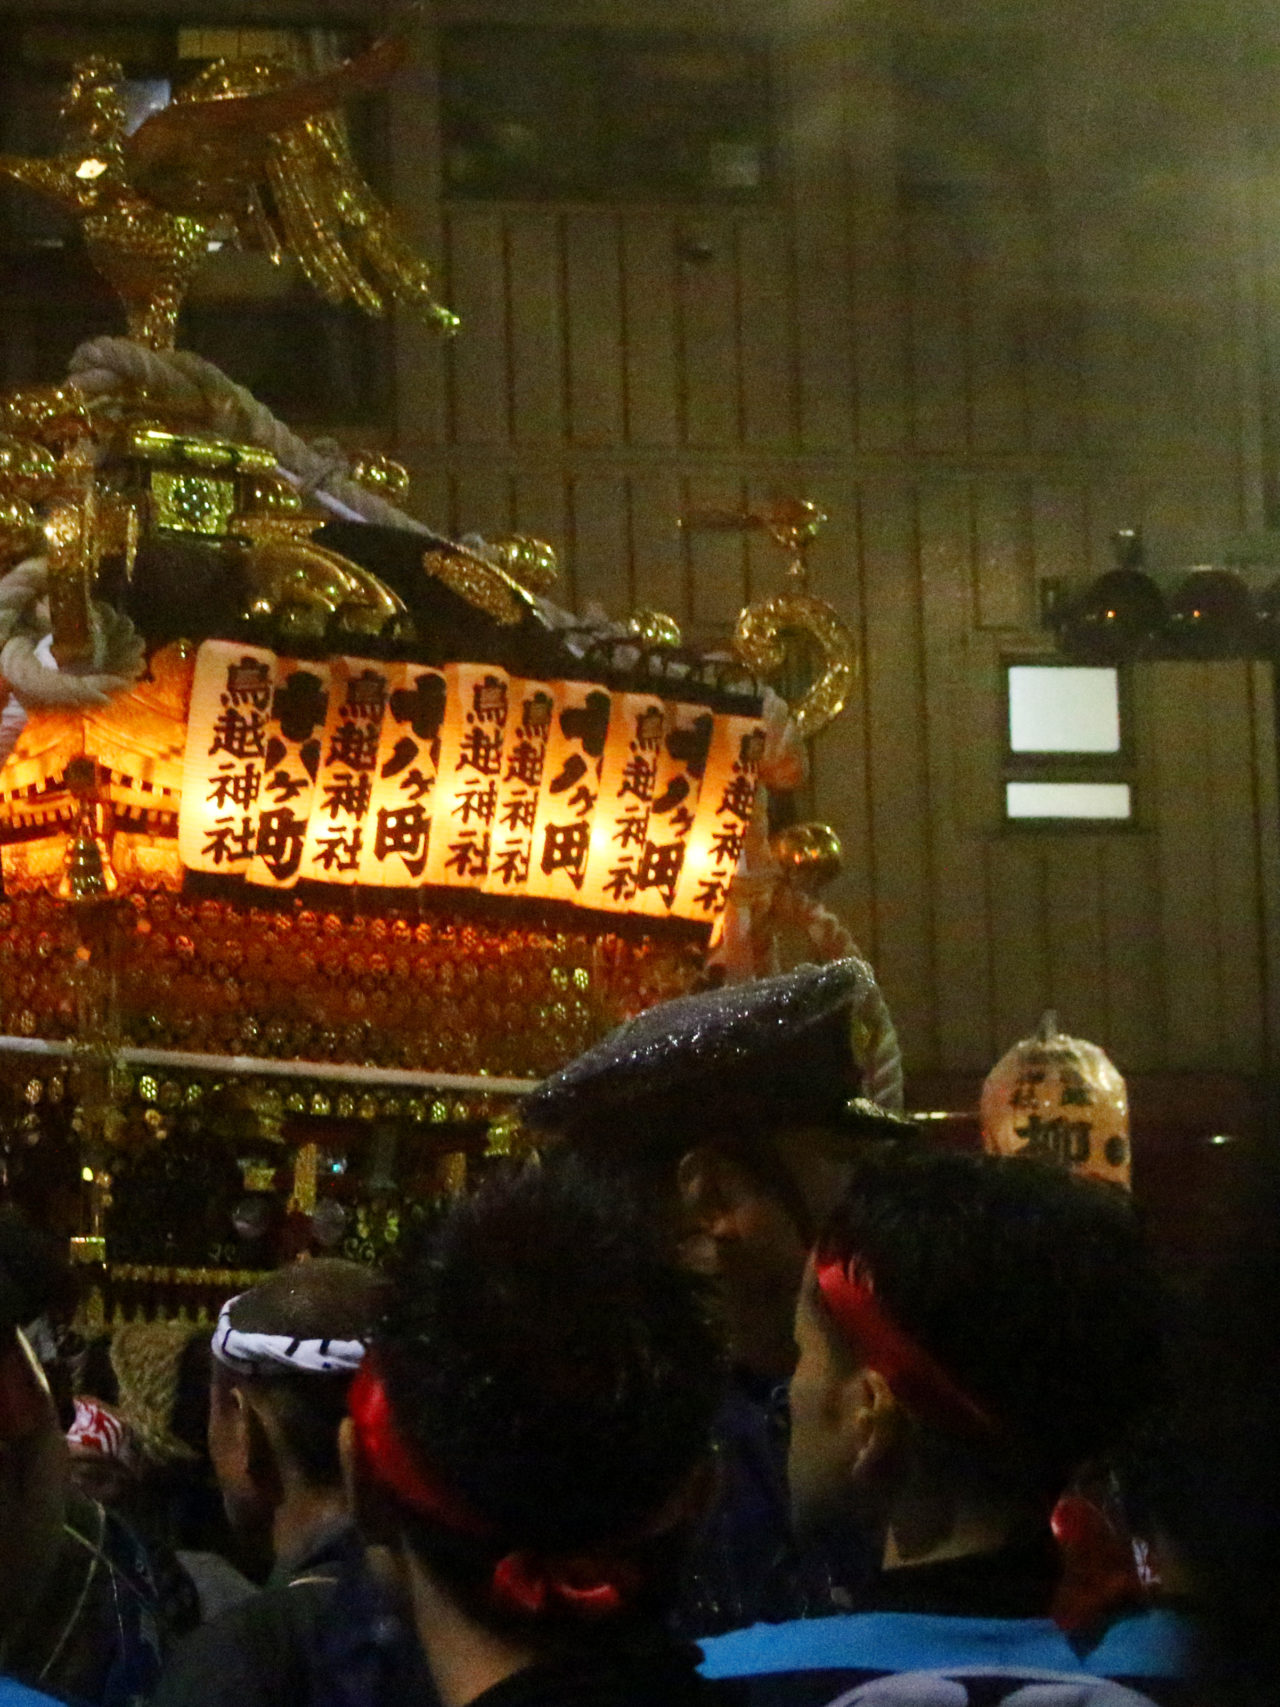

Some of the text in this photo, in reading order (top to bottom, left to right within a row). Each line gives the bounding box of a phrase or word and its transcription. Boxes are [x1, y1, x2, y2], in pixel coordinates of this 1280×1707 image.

[202, 656, 271, 864] 鳥越神社
[312, 668, 387, 871] 鳥越神社
[445, 676, 508, 877] 鳥越神社
